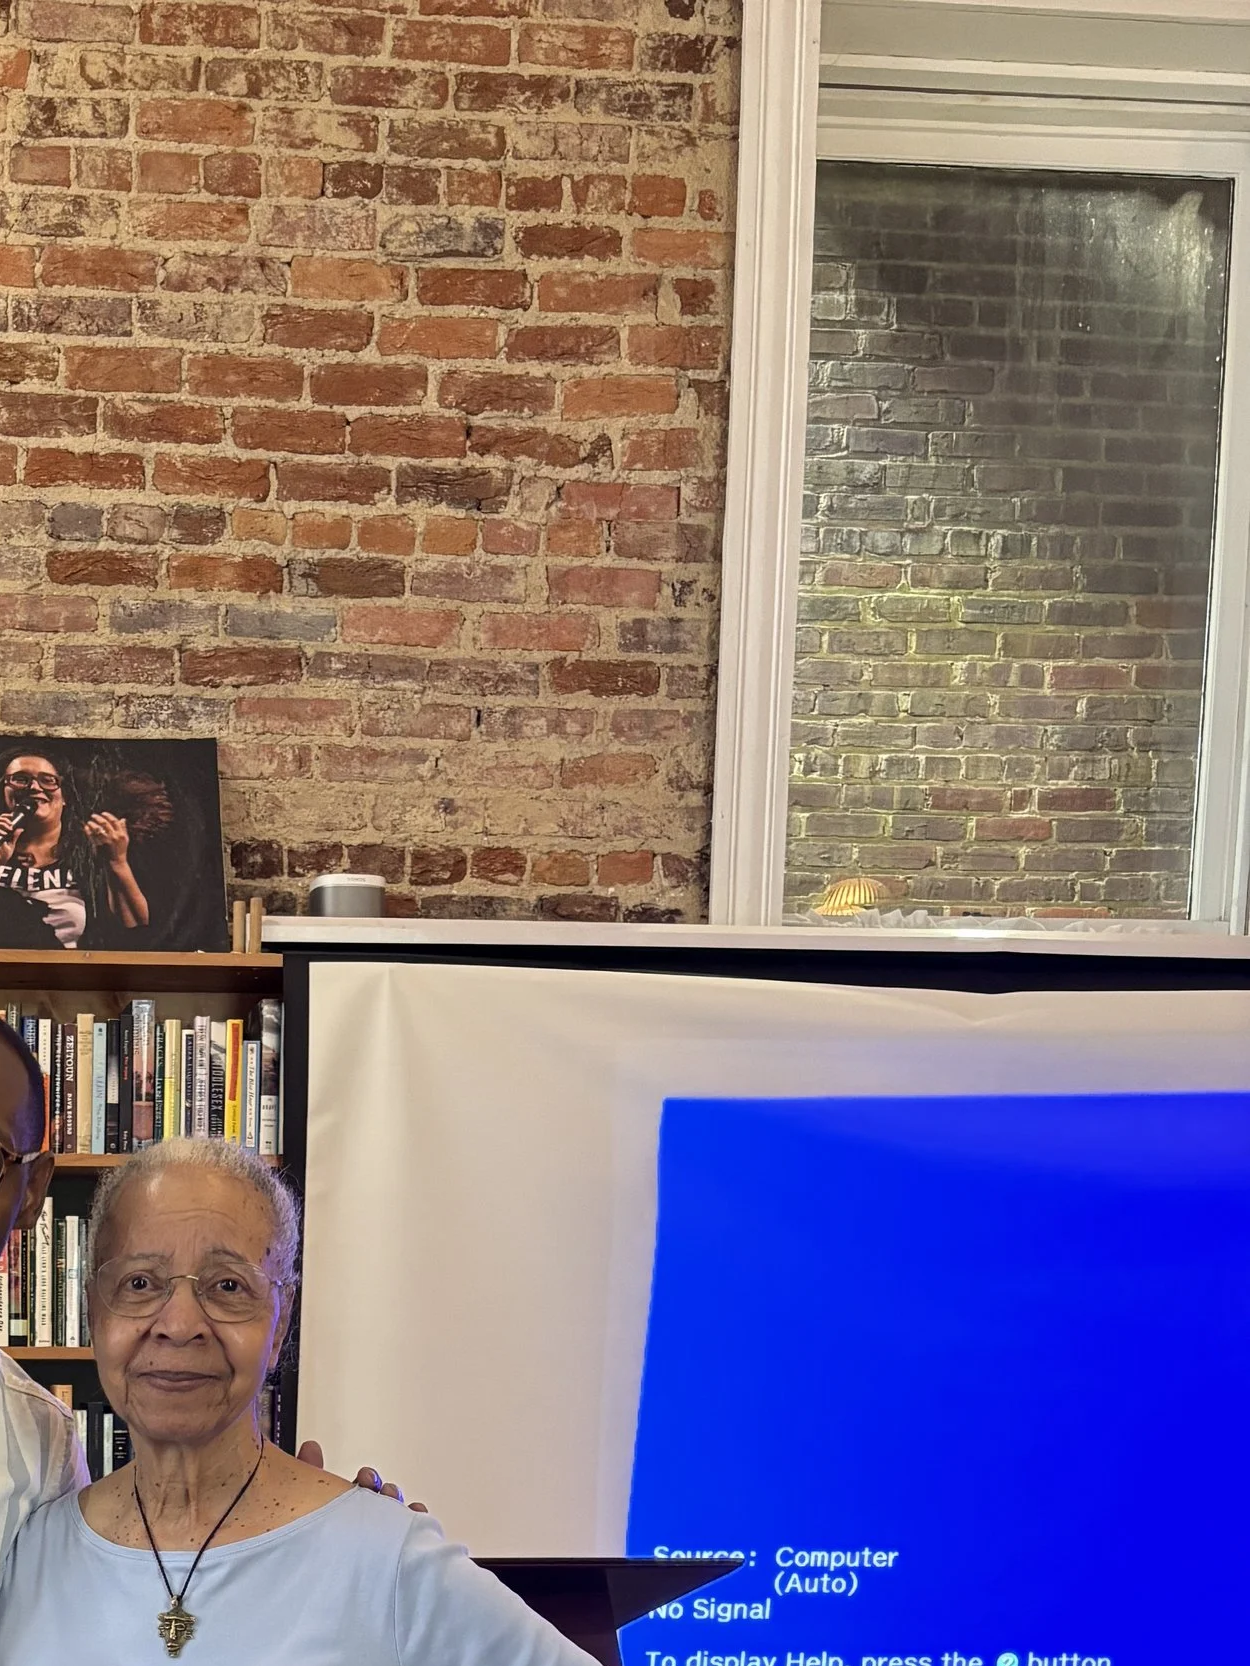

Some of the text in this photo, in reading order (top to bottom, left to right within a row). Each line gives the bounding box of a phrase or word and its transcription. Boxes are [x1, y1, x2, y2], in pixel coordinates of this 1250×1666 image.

[66, 1035, 74, 1082] ZEITOUN
[774, 1546, 899, 1571] Computer
[773, 1571, 859, 1597] (Auto)
[692, 1597, 771, 1623] Signal
